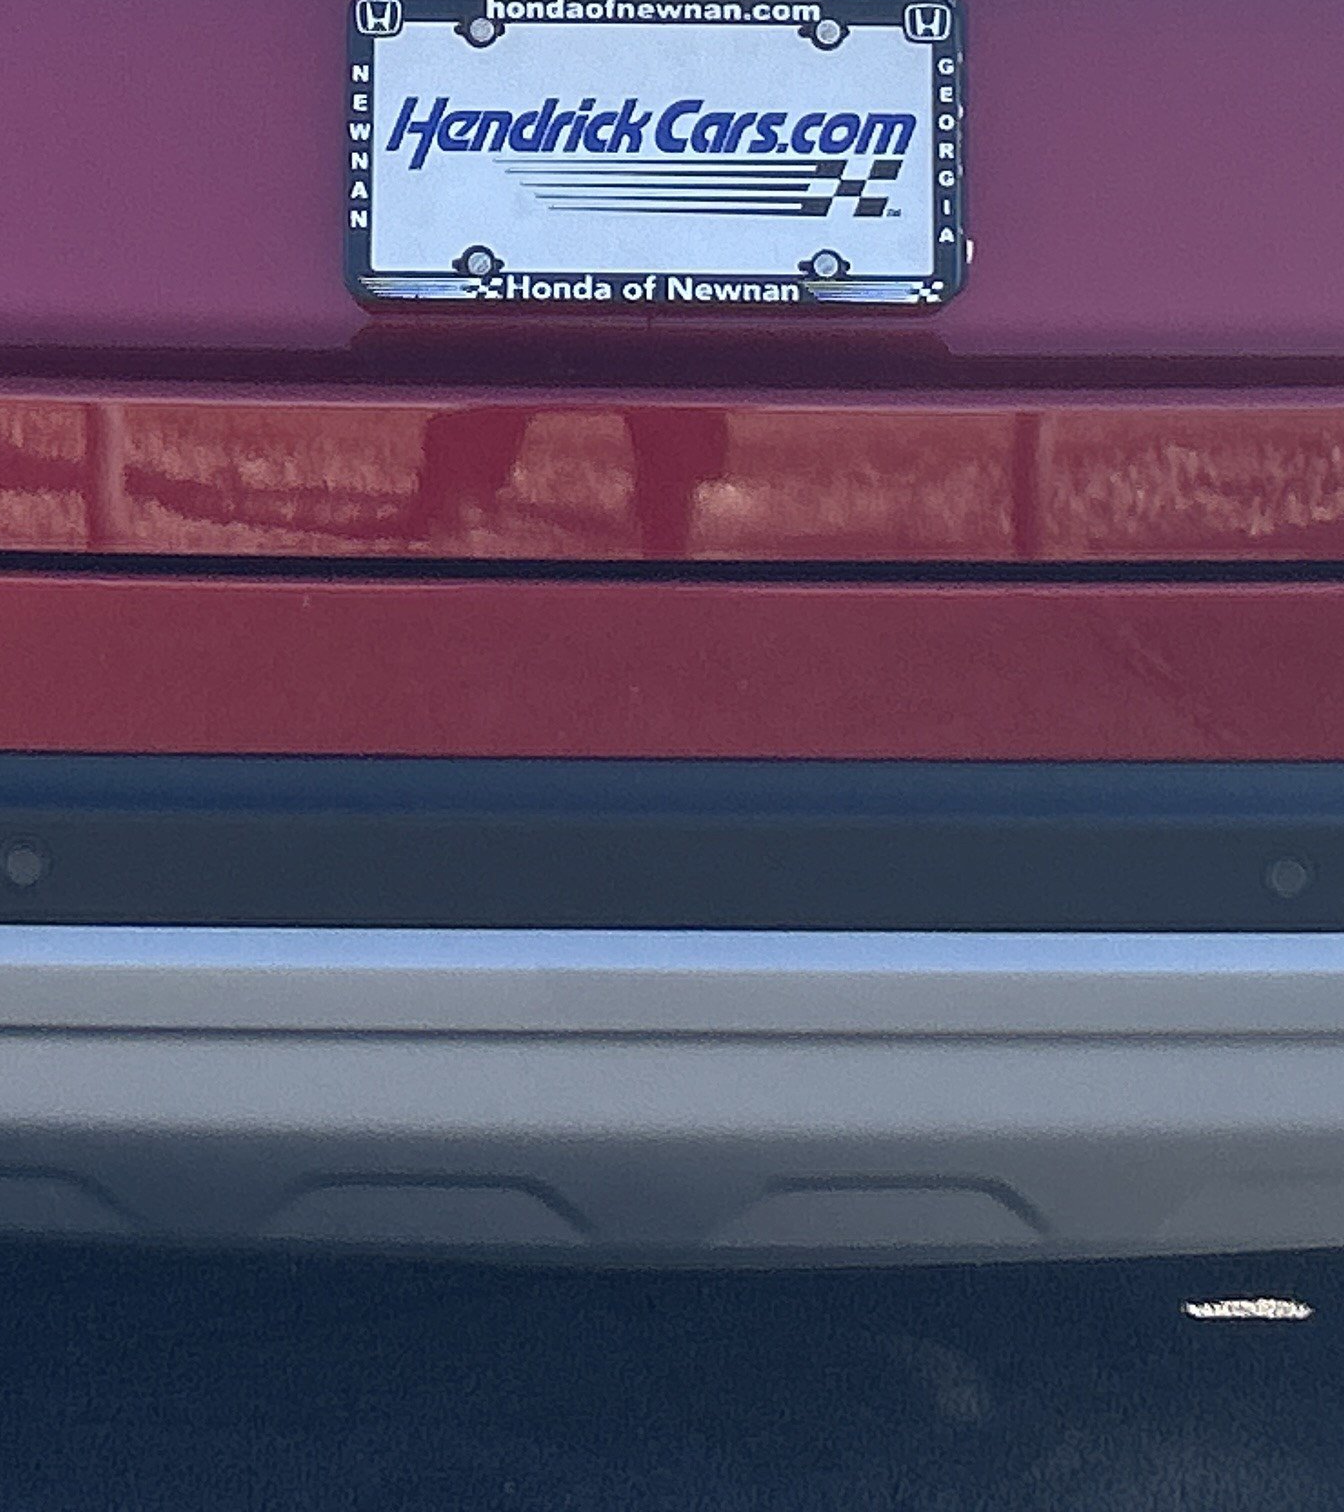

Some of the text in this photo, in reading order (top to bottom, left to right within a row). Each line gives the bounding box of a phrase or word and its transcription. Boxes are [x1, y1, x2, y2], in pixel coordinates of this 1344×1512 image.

[348, 63, 371, 229] NEWNAN
[937, 56, 956, 244] GEORGIA
[505, 275, 800, 303] Honda of Newnan
